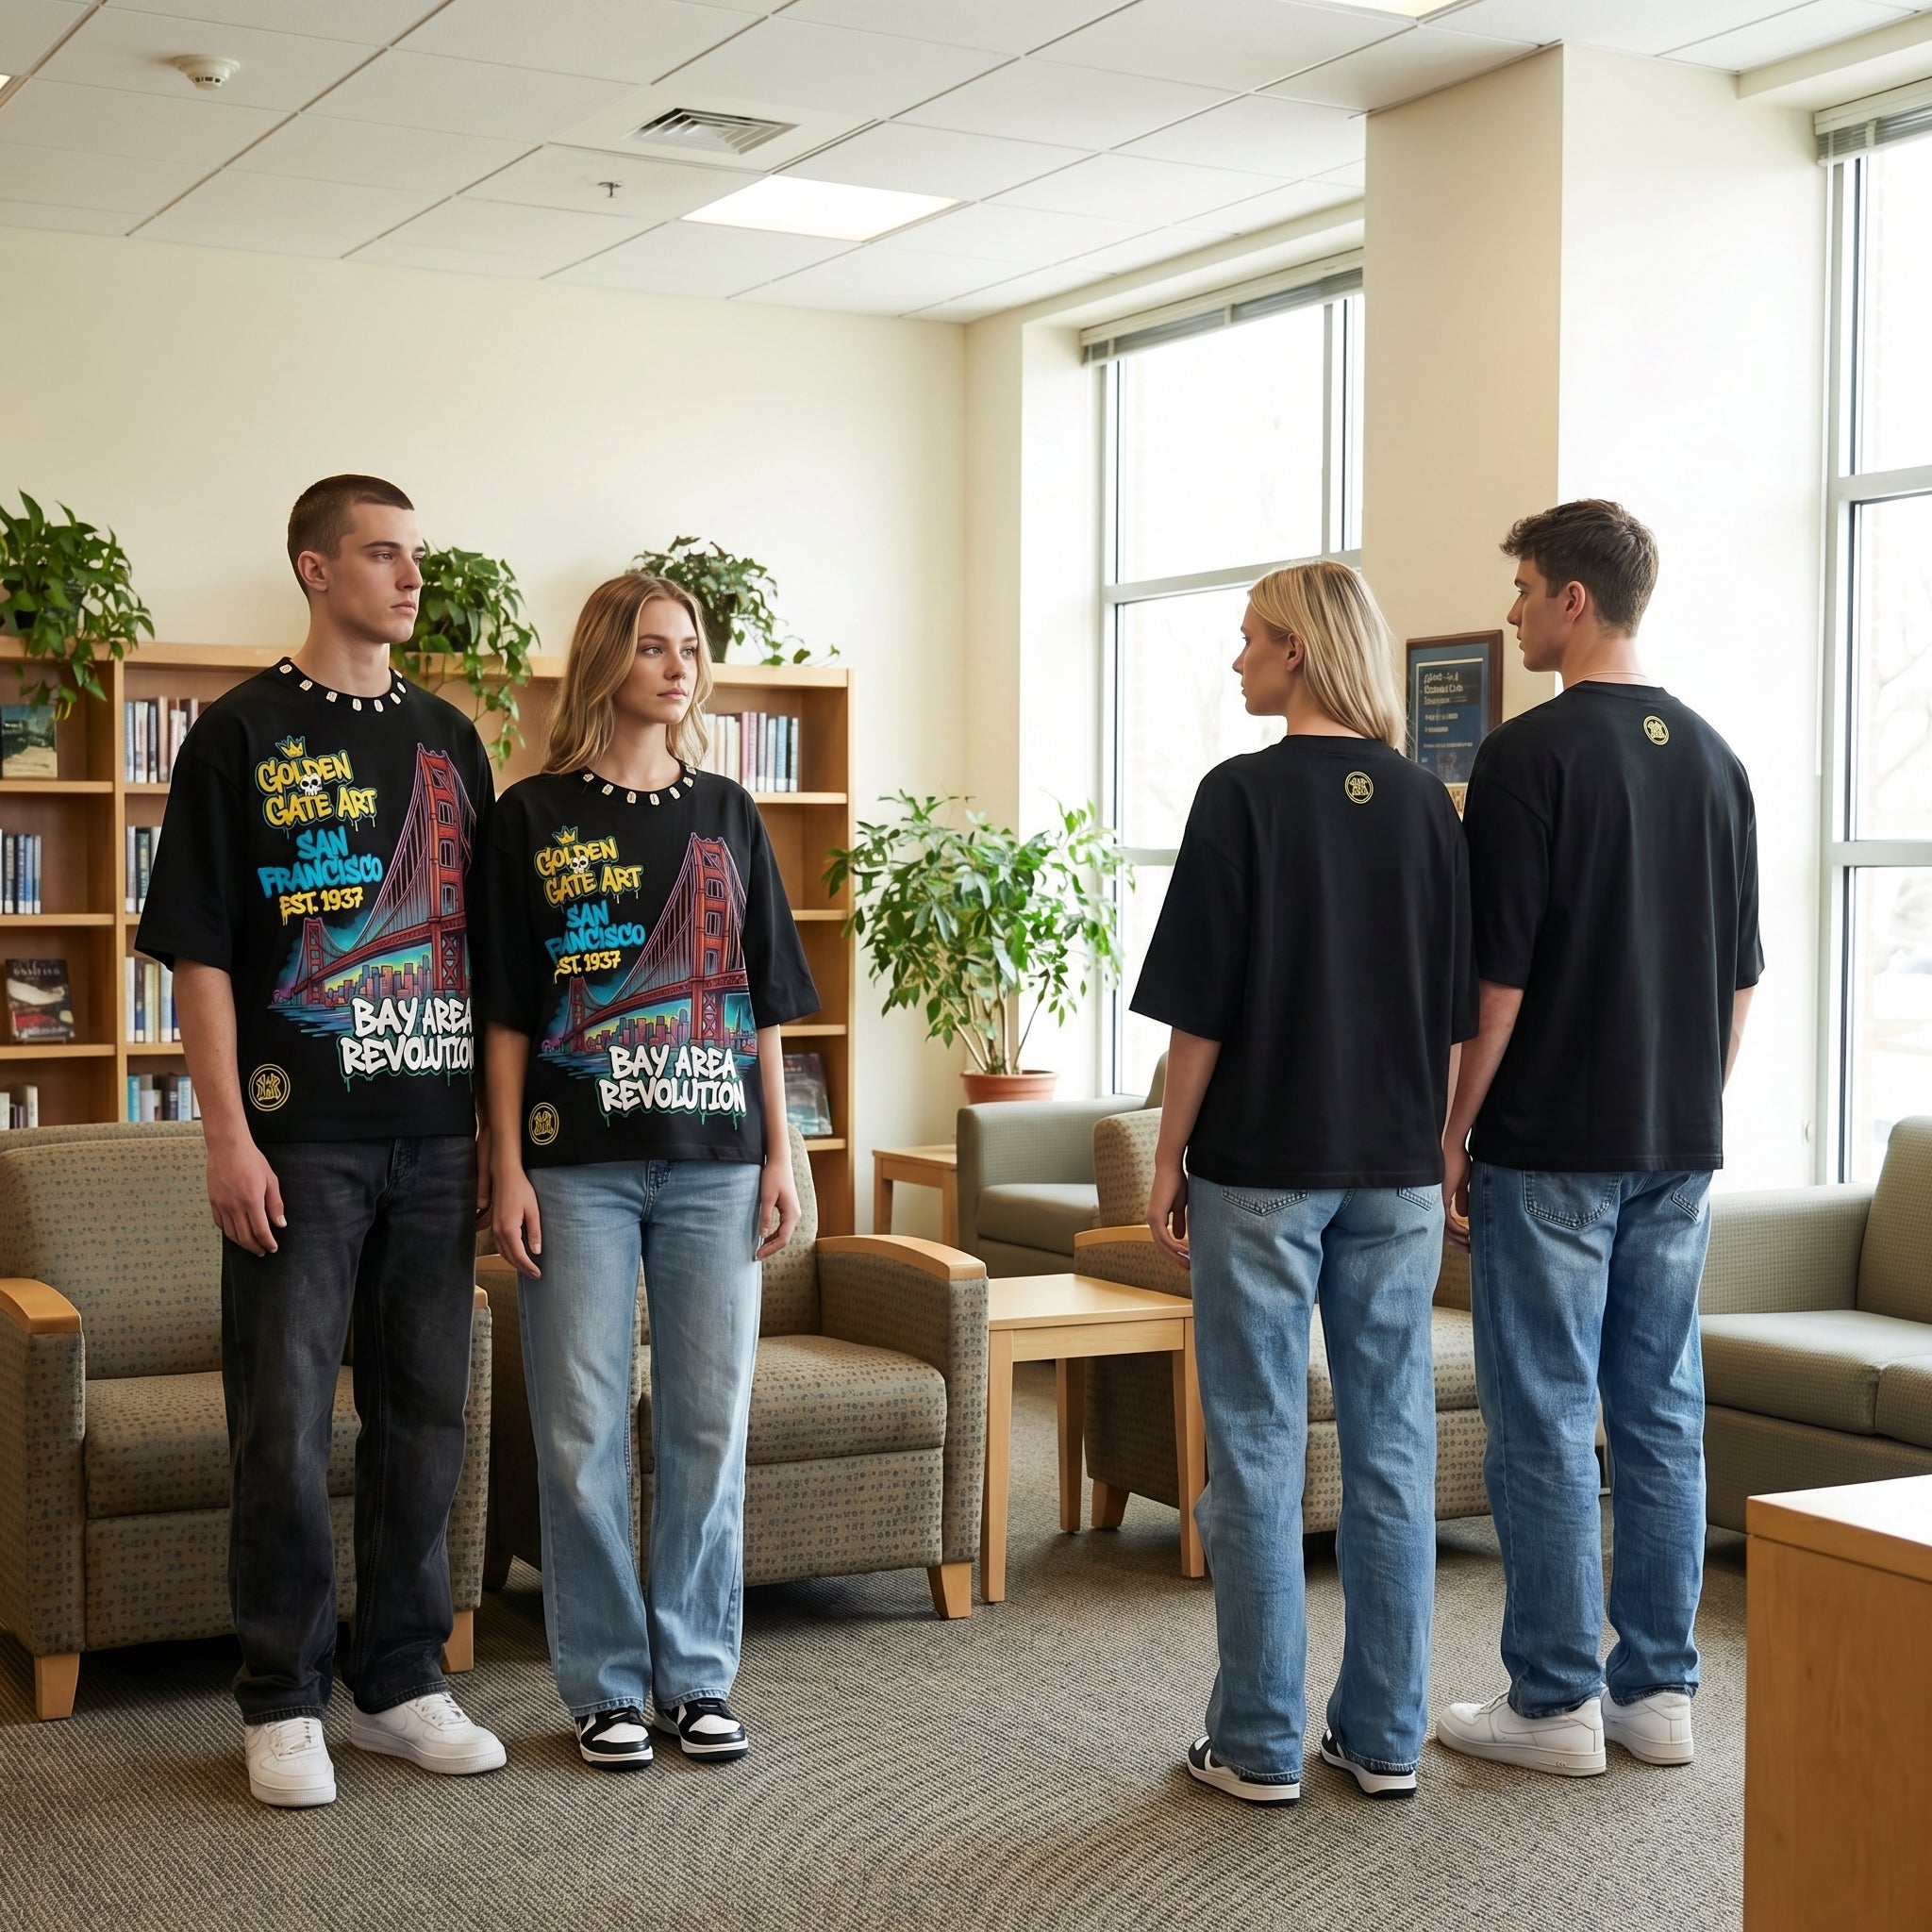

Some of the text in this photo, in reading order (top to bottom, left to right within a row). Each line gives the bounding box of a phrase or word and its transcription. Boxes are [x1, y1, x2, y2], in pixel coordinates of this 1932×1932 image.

[256, 751, 353, 794] GOLDEN
[265, 786, 376, 826] GATE ART
[296, 825, 349, 859] SAN
[536, 837, 618, 876] GOLDEN
[258, 853, 384, 898] FRANCISCO
[545, 865, 642, 905] GATE ART
[279, 887, 363, 919] EST. 1937
[566, 899, 609, 928] SAN
[555, 950, 622, 977] ST. 1937
[352, 997, 472, 1037] BAY AREA
[608, 1044, 737, 1079] BAY AREA
[598, 1075, 747, 1113] REVOLUTION
